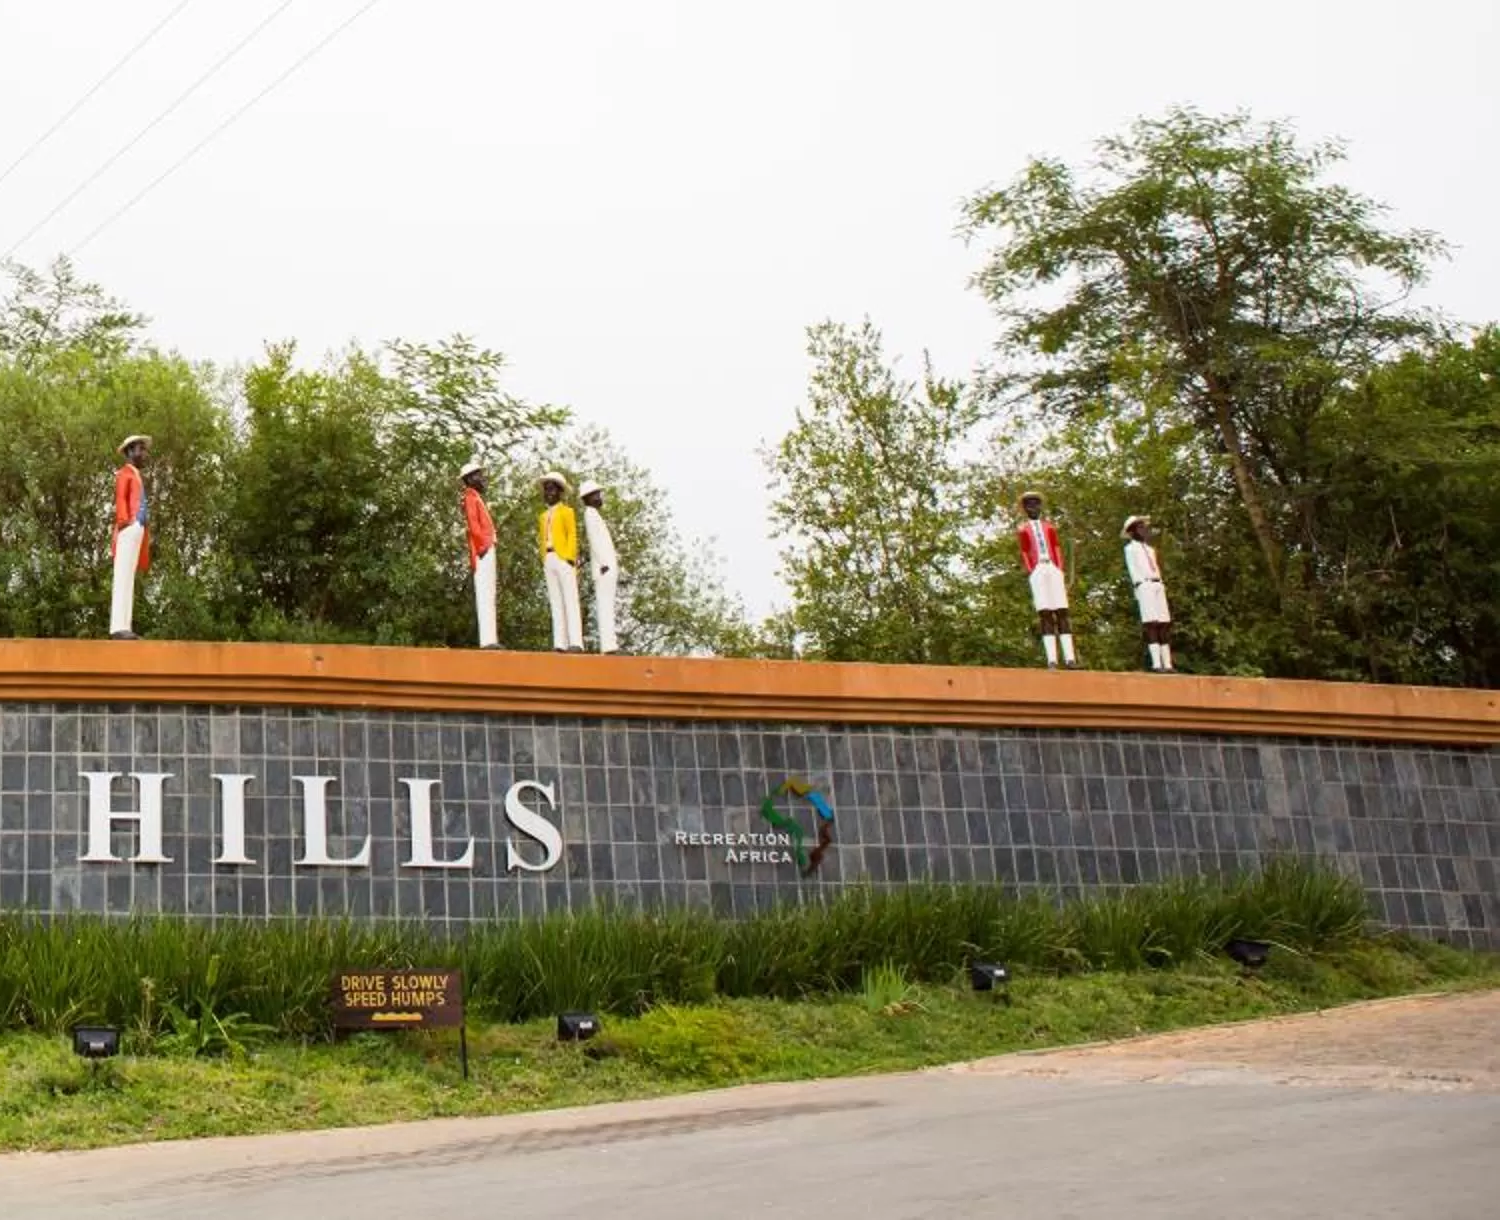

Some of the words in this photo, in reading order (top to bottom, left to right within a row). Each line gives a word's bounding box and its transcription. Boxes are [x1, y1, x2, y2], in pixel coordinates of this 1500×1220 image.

[77, 770, 565, 872] HILLS
[675, 830, 790, 846] RECREATION
[725, 848, 793, 864] AFRICA
[341, 975, 385, 991] DRIVE
[391, 975, 449, 990] SLOWLY
[344, 991, 387, 1007] SPEED
[391, 991, 445, 1007] HUMPS
